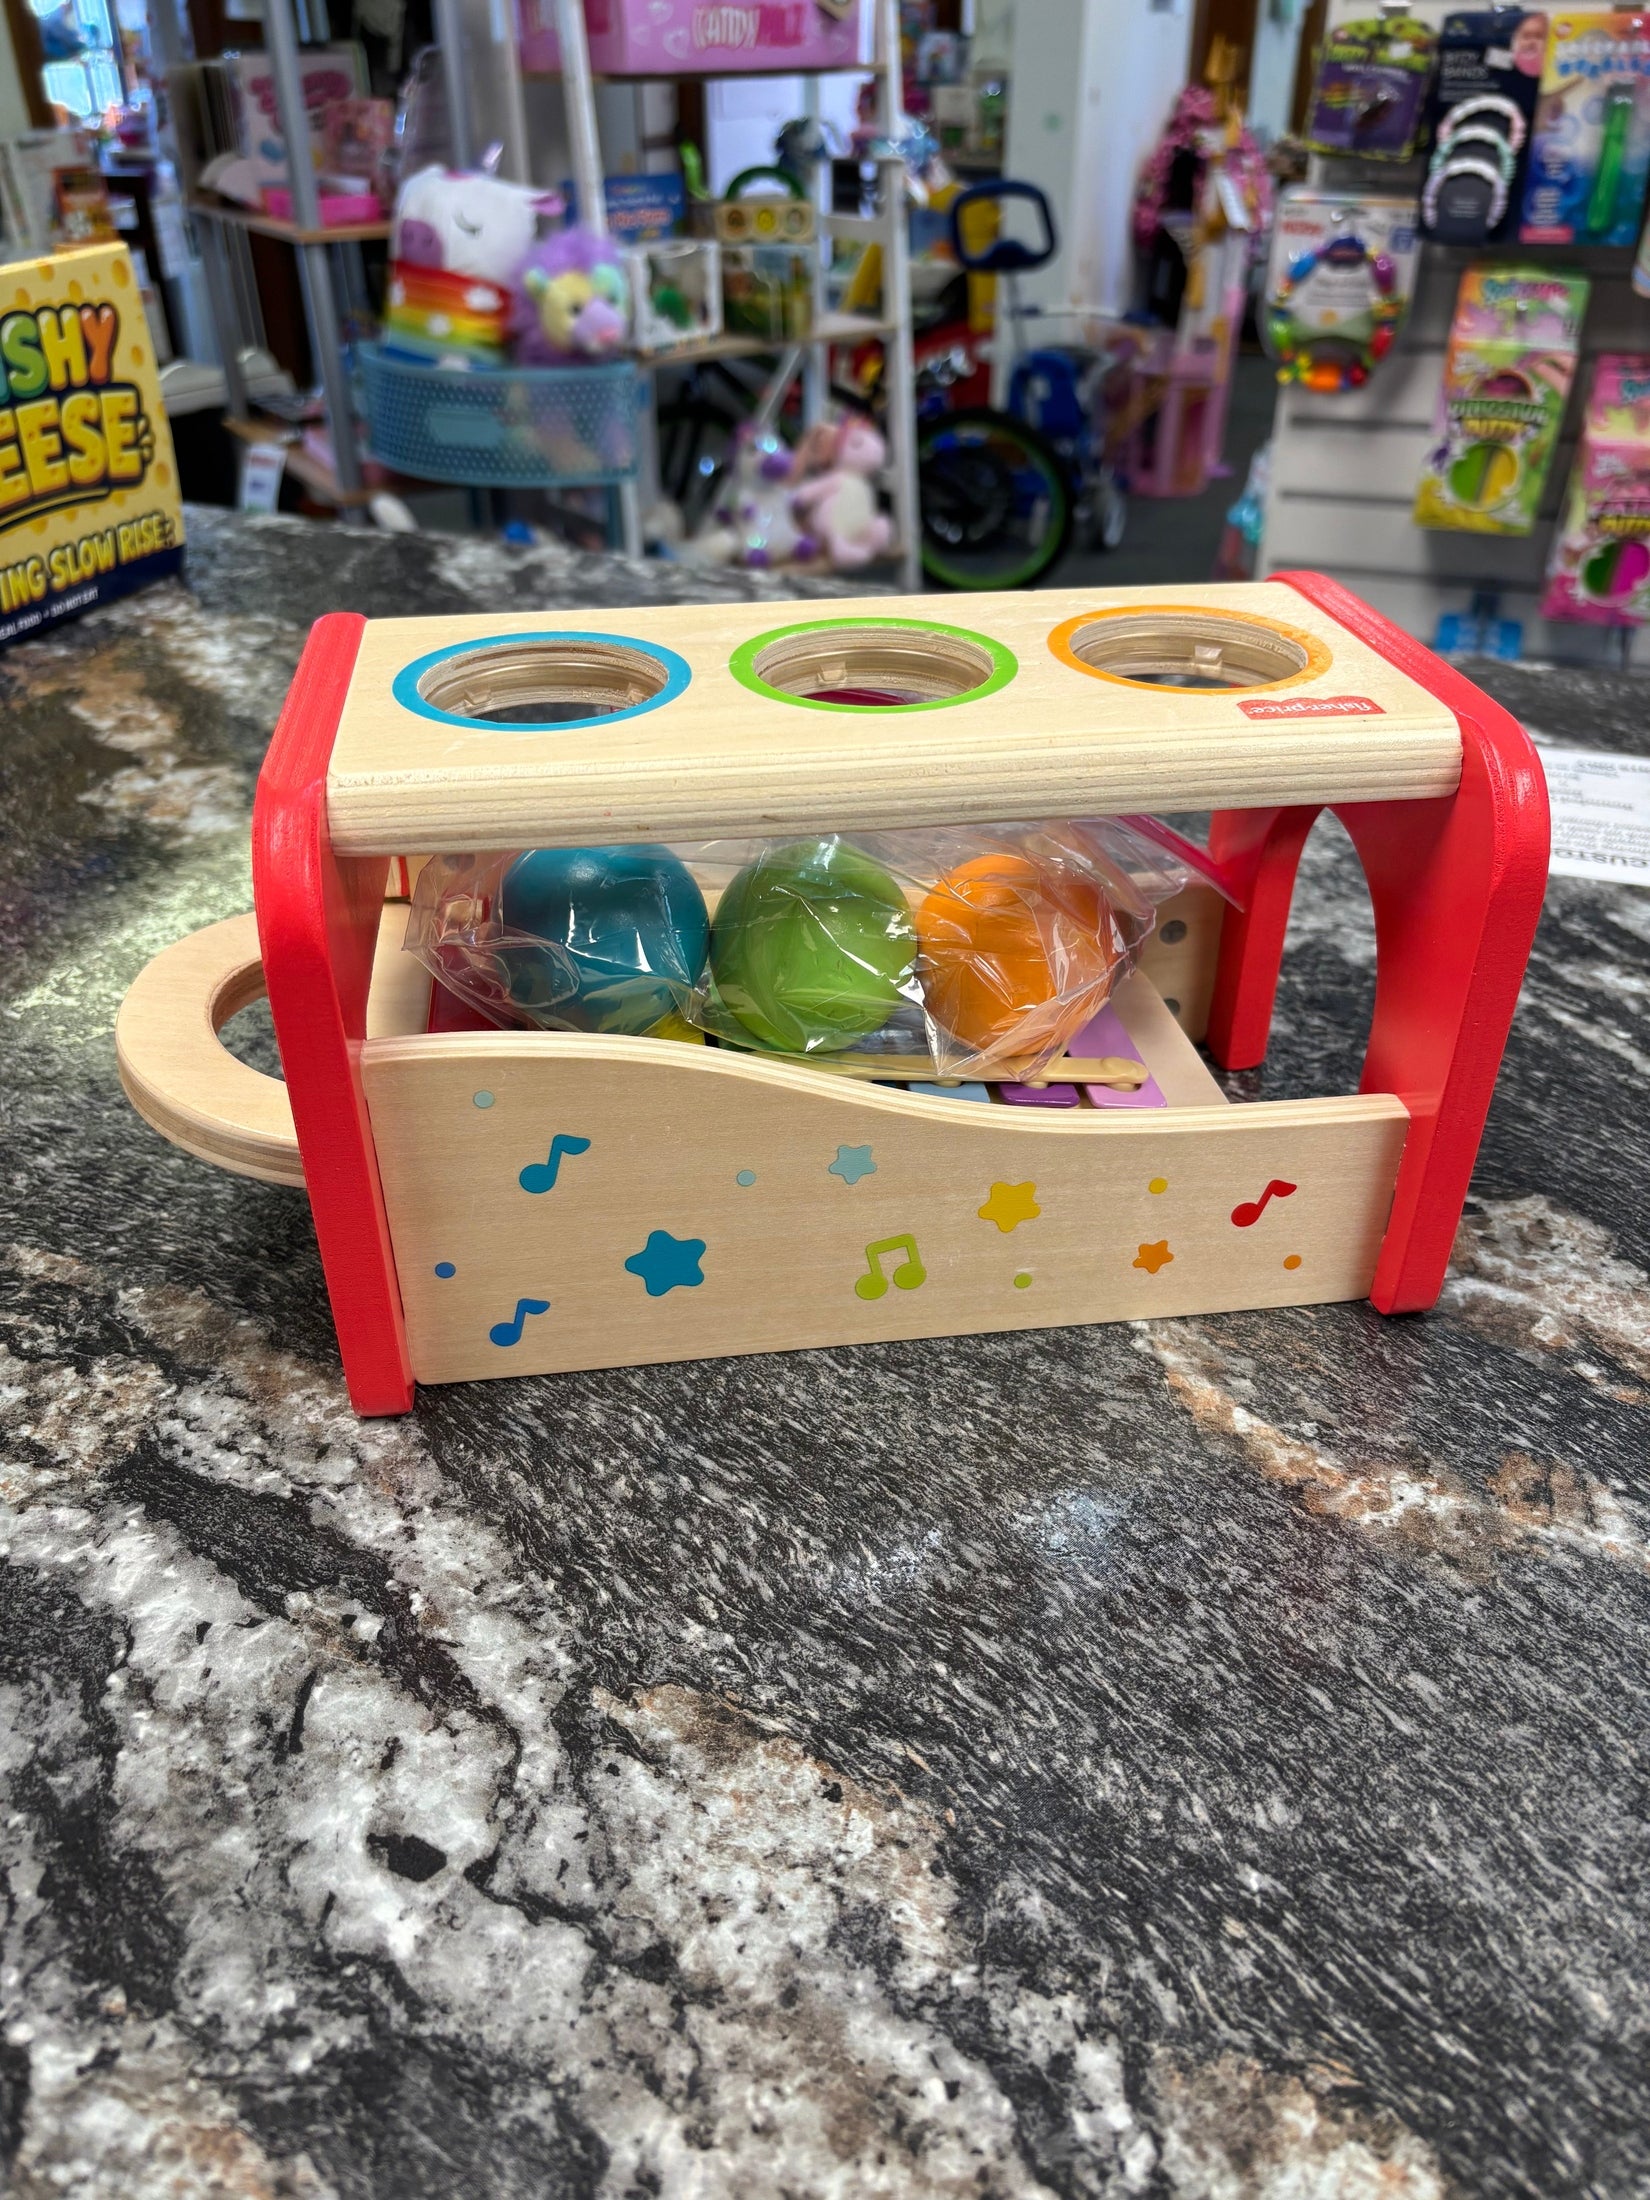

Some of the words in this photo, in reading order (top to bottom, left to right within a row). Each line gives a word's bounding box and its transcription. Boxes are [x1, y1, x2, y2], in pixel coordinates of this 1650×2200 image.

[0, 305, 117, 402] SHY
[49, 527, 117, 592] SLOW
[117, 513, 165, 565] RISE
